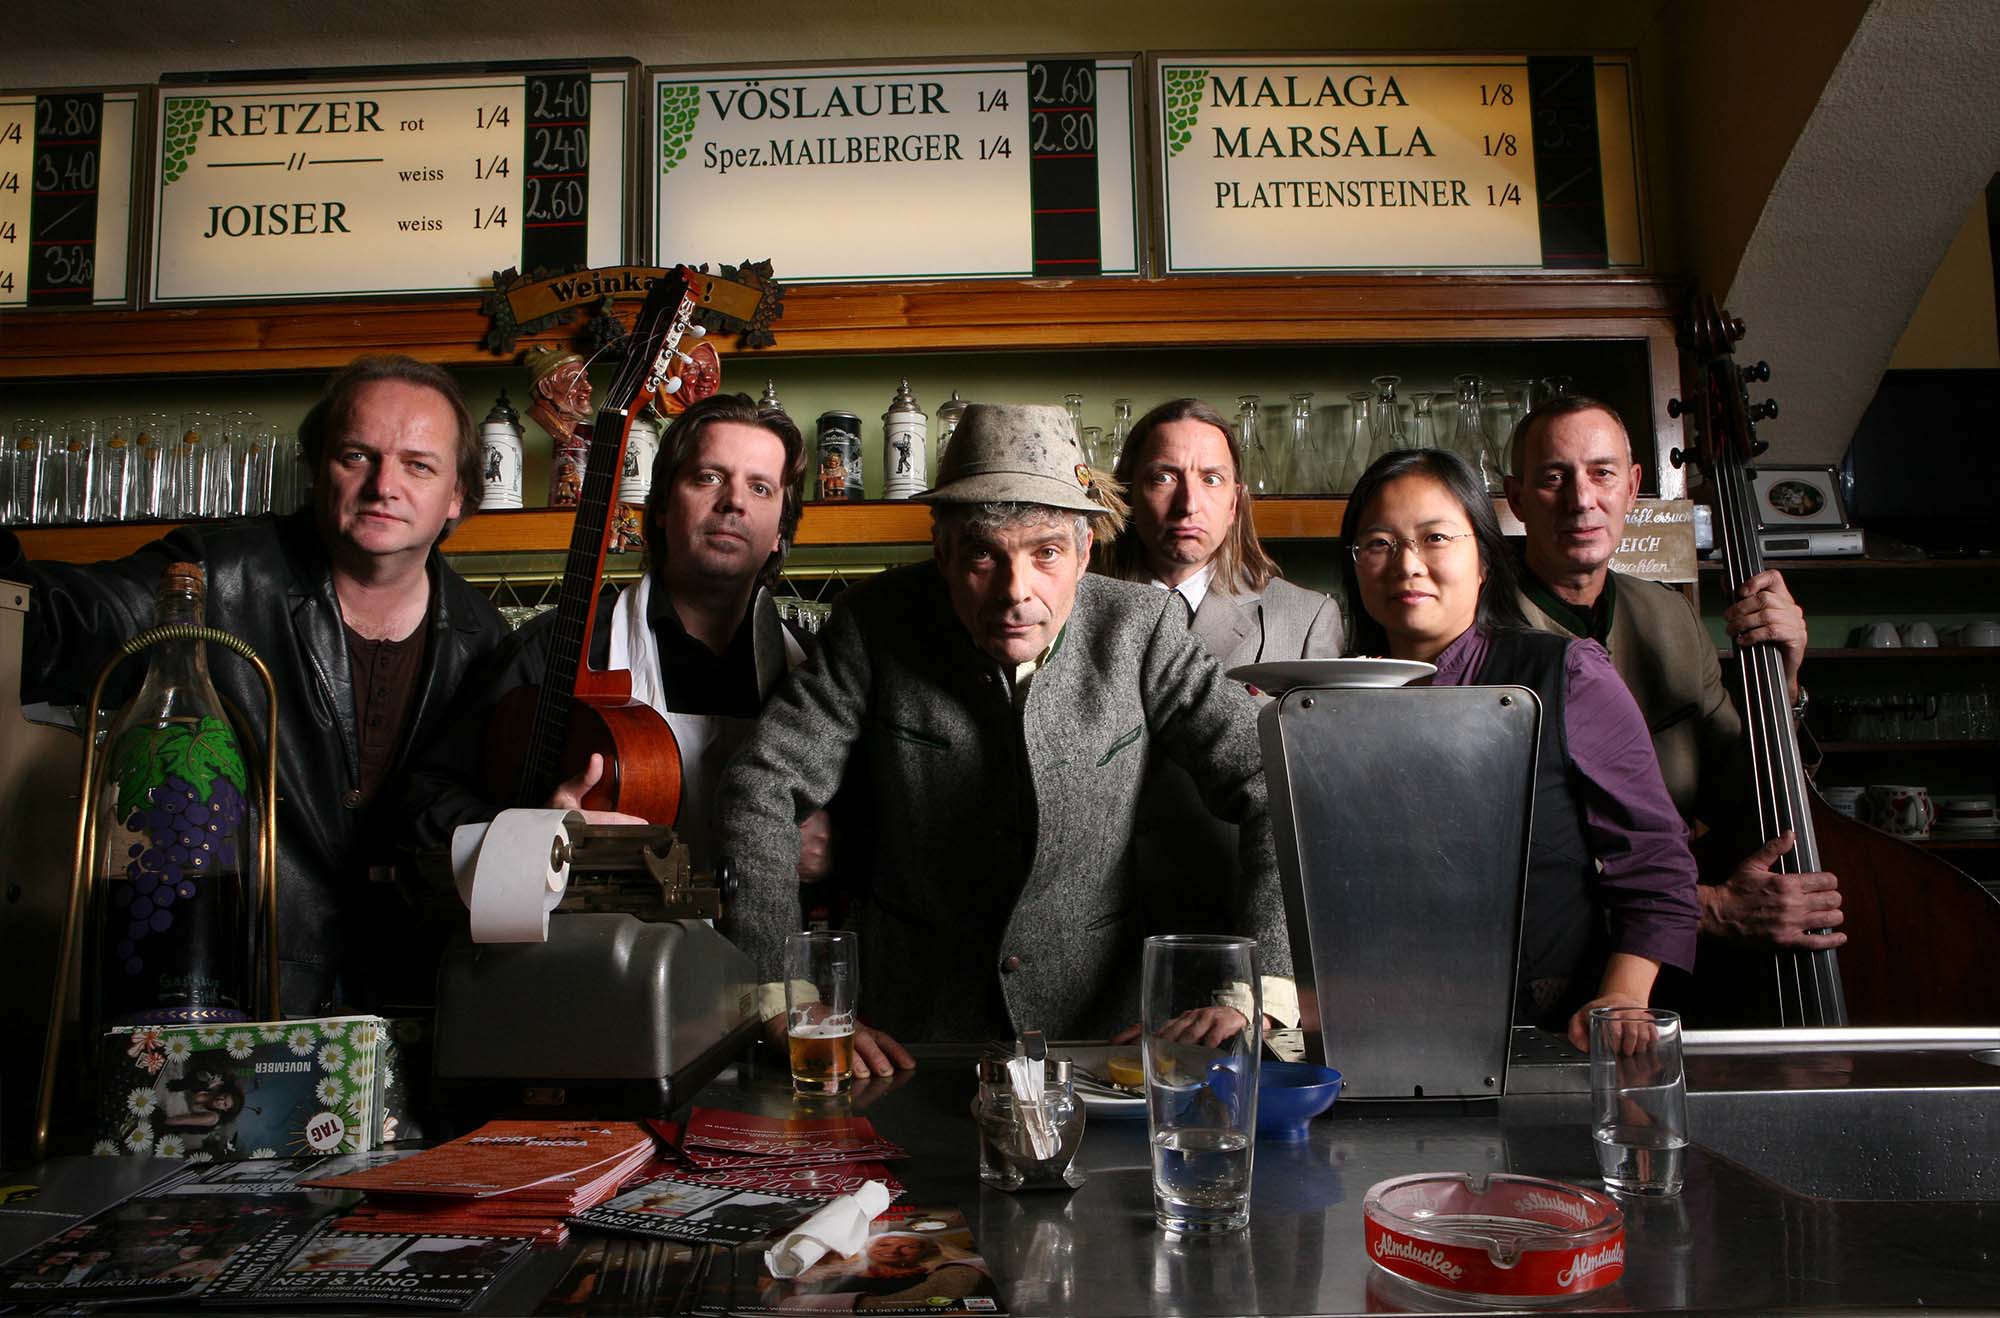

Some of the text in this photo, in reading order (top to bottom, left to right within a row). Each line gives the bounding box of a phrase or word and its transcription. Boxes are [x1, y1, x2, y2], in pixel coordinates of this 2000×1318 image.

[706, 63, 1094, 121] VÖSLAUER 1/4 2.60
[1210, 74, 1514, 108] MALAGA 1/8
[0, 98, 97, 146] /4 2.80
[207, 100, 384, 138] RETZER
[400, 116, 425, 132] rot
[475, 105, 510, 130] 1/4
[977, 138, 1012, 161] 1/4
[1031, 111, 1095, 152] 2.80
[1213, 125, 1436, 159] MARSALA
[1482, 133, 1518, 157] 1/8
[398, 165, 444, 183] weiss
[473, 156, 510, 181] 1/4
[1214, 178, 1521, 208] PLATTENSTEINER 1/4
[203, 201, 350, 239] JOISER
[397, 215, 444, 232] weiss
[472, 205, 508, 230] 1/4
[1614, 535, 1661, 555] EICH
[255, 1061, 311, 1073] NOVEMBER
[310, 1119, 341, 1142] TAG
[578, 1210, 640, 1227] KUNST
[640, 1219, 656, 1228] &
[656, 1223, 708, 1235] KINO
[1374, 1231, 1464, 1280] Almdudler
[1557, 1241, 1625, 1287] Almdudle
[271, 1277, 329, 1286] NST
[352, 1277, 419, 1287] KINO
